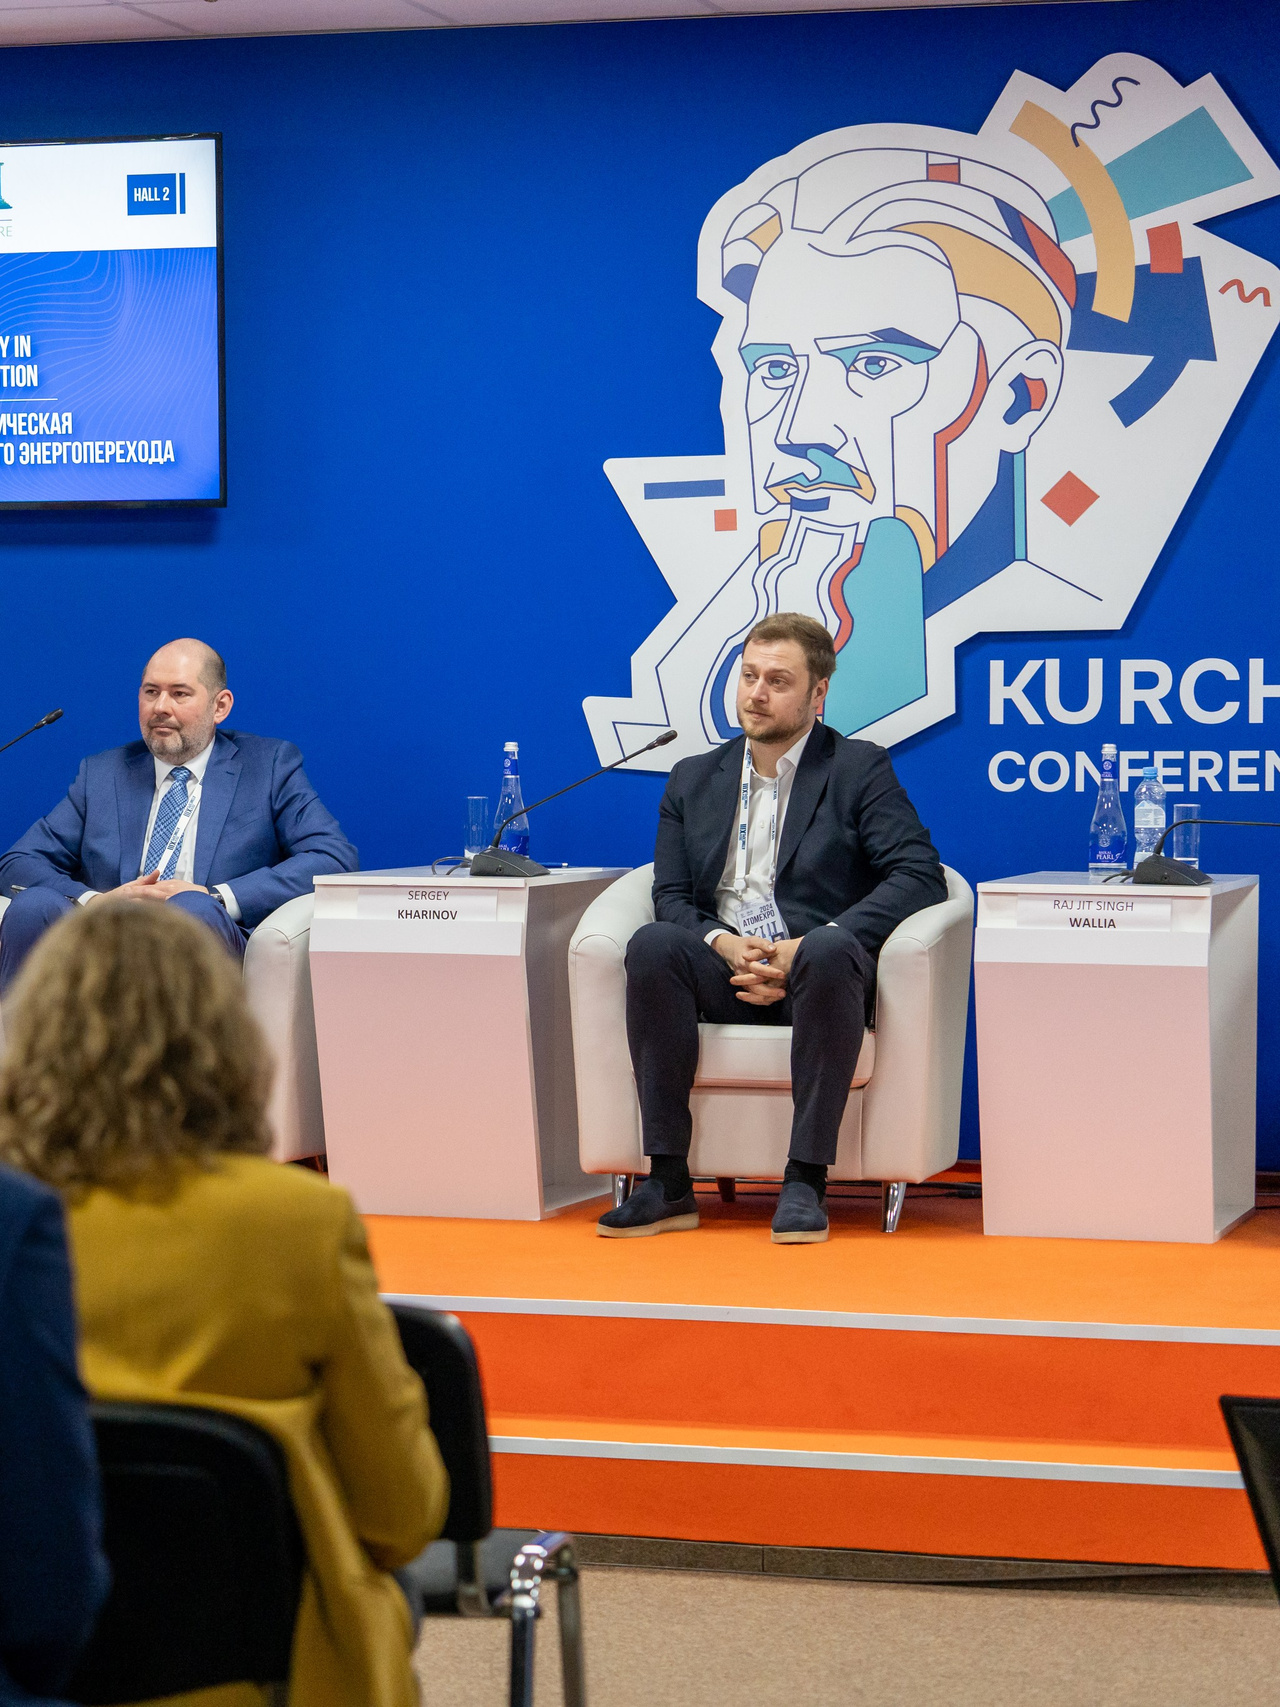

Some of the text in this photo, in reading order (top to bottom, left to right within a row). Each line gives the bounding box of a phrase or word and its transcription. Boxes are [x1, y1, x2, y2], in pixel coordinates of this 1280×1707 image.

[133, 186, 170, 202] HALL 2
[14, 335, 31, 358] IN
[19, 440, 176, 465] ЭНЕРГОПЕРЕХОДА
[407, 890, 450, 901] SERGEY
[759, 903, 773, 913] 2024
[1053, 900, 1134, 911] RAJ JIT SINGH
[397, 909, 458, 920] KHARINOV
[742, 909, 776, 928] ATOMEXPO
[1069, 917, 1117, 928] WALLIA
